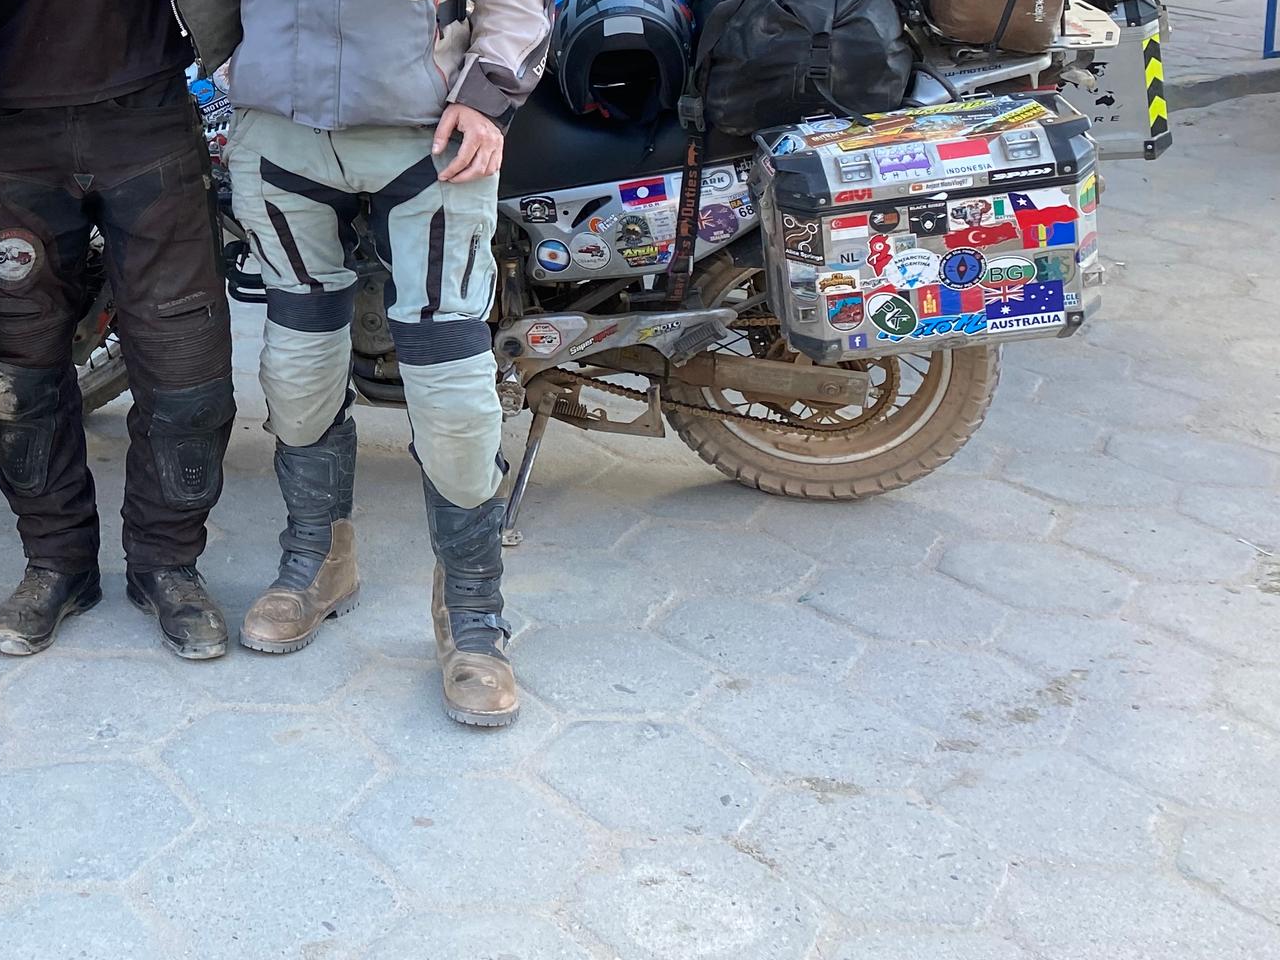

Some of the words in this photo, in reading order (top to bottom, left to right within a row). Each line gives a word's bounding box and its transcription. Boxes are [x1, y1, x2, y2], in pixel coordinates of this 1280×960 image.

[881, 168, 932, 180] CHILE
[946, 163, 993, 175] INDONESIA
[991, 167, 1053, 181] SPIDI
[681, 169, 698, 217] Duties
[834, 188, 873, 203] GIVI
[738, 204, 754, 218] 68
[623, 245, 659, 257] Andy
[800, 251, 824, 262] Springs
[840, 252, 860, 264] NL
[894, 255, 931, 265] ANTARCTICA
[989, 264, 1024, 283] BG
[875, 299, 911, 331] PK
[990, 314, 1062, 331] AUSTRALIA
